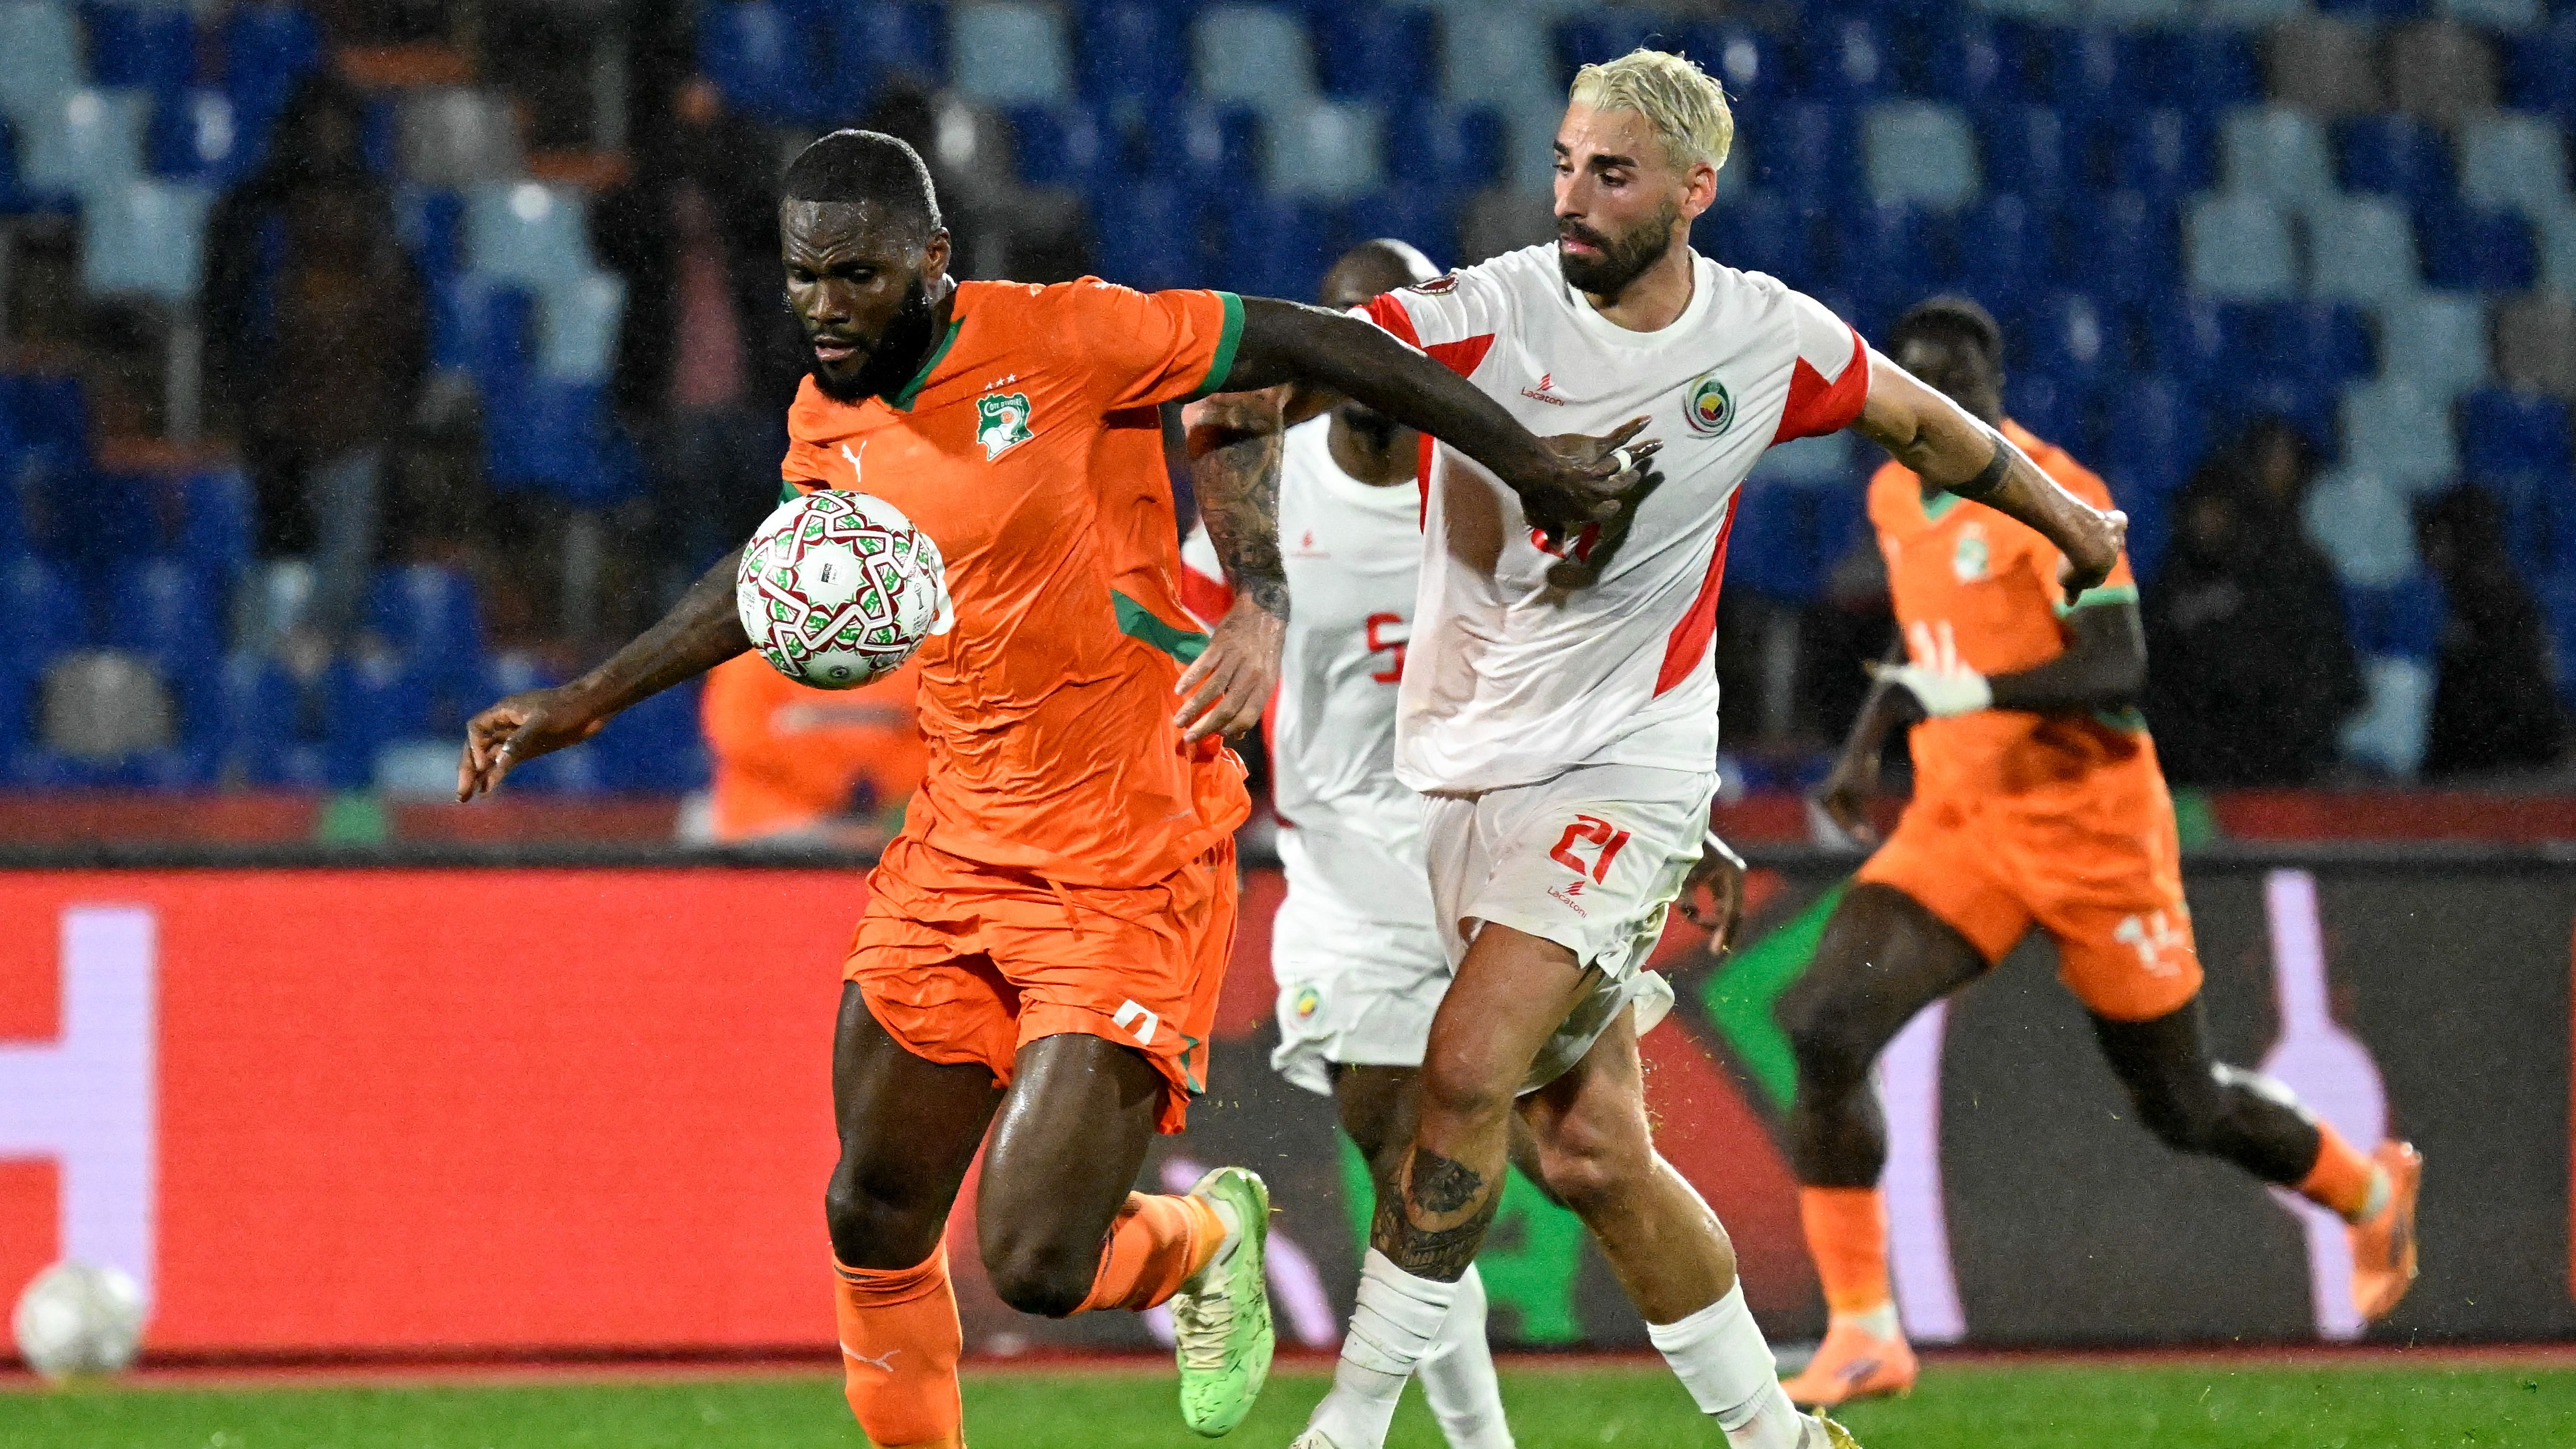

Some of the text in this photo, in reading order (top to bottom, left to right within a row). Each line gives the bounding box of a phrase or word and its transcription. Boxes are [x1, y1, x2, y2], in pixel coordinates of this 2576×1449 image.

[1366, 612, 1405, 682] 5
[1550, 814, 1631, 885] 21
[1547, 885, 1587, 919] Lacatoni
